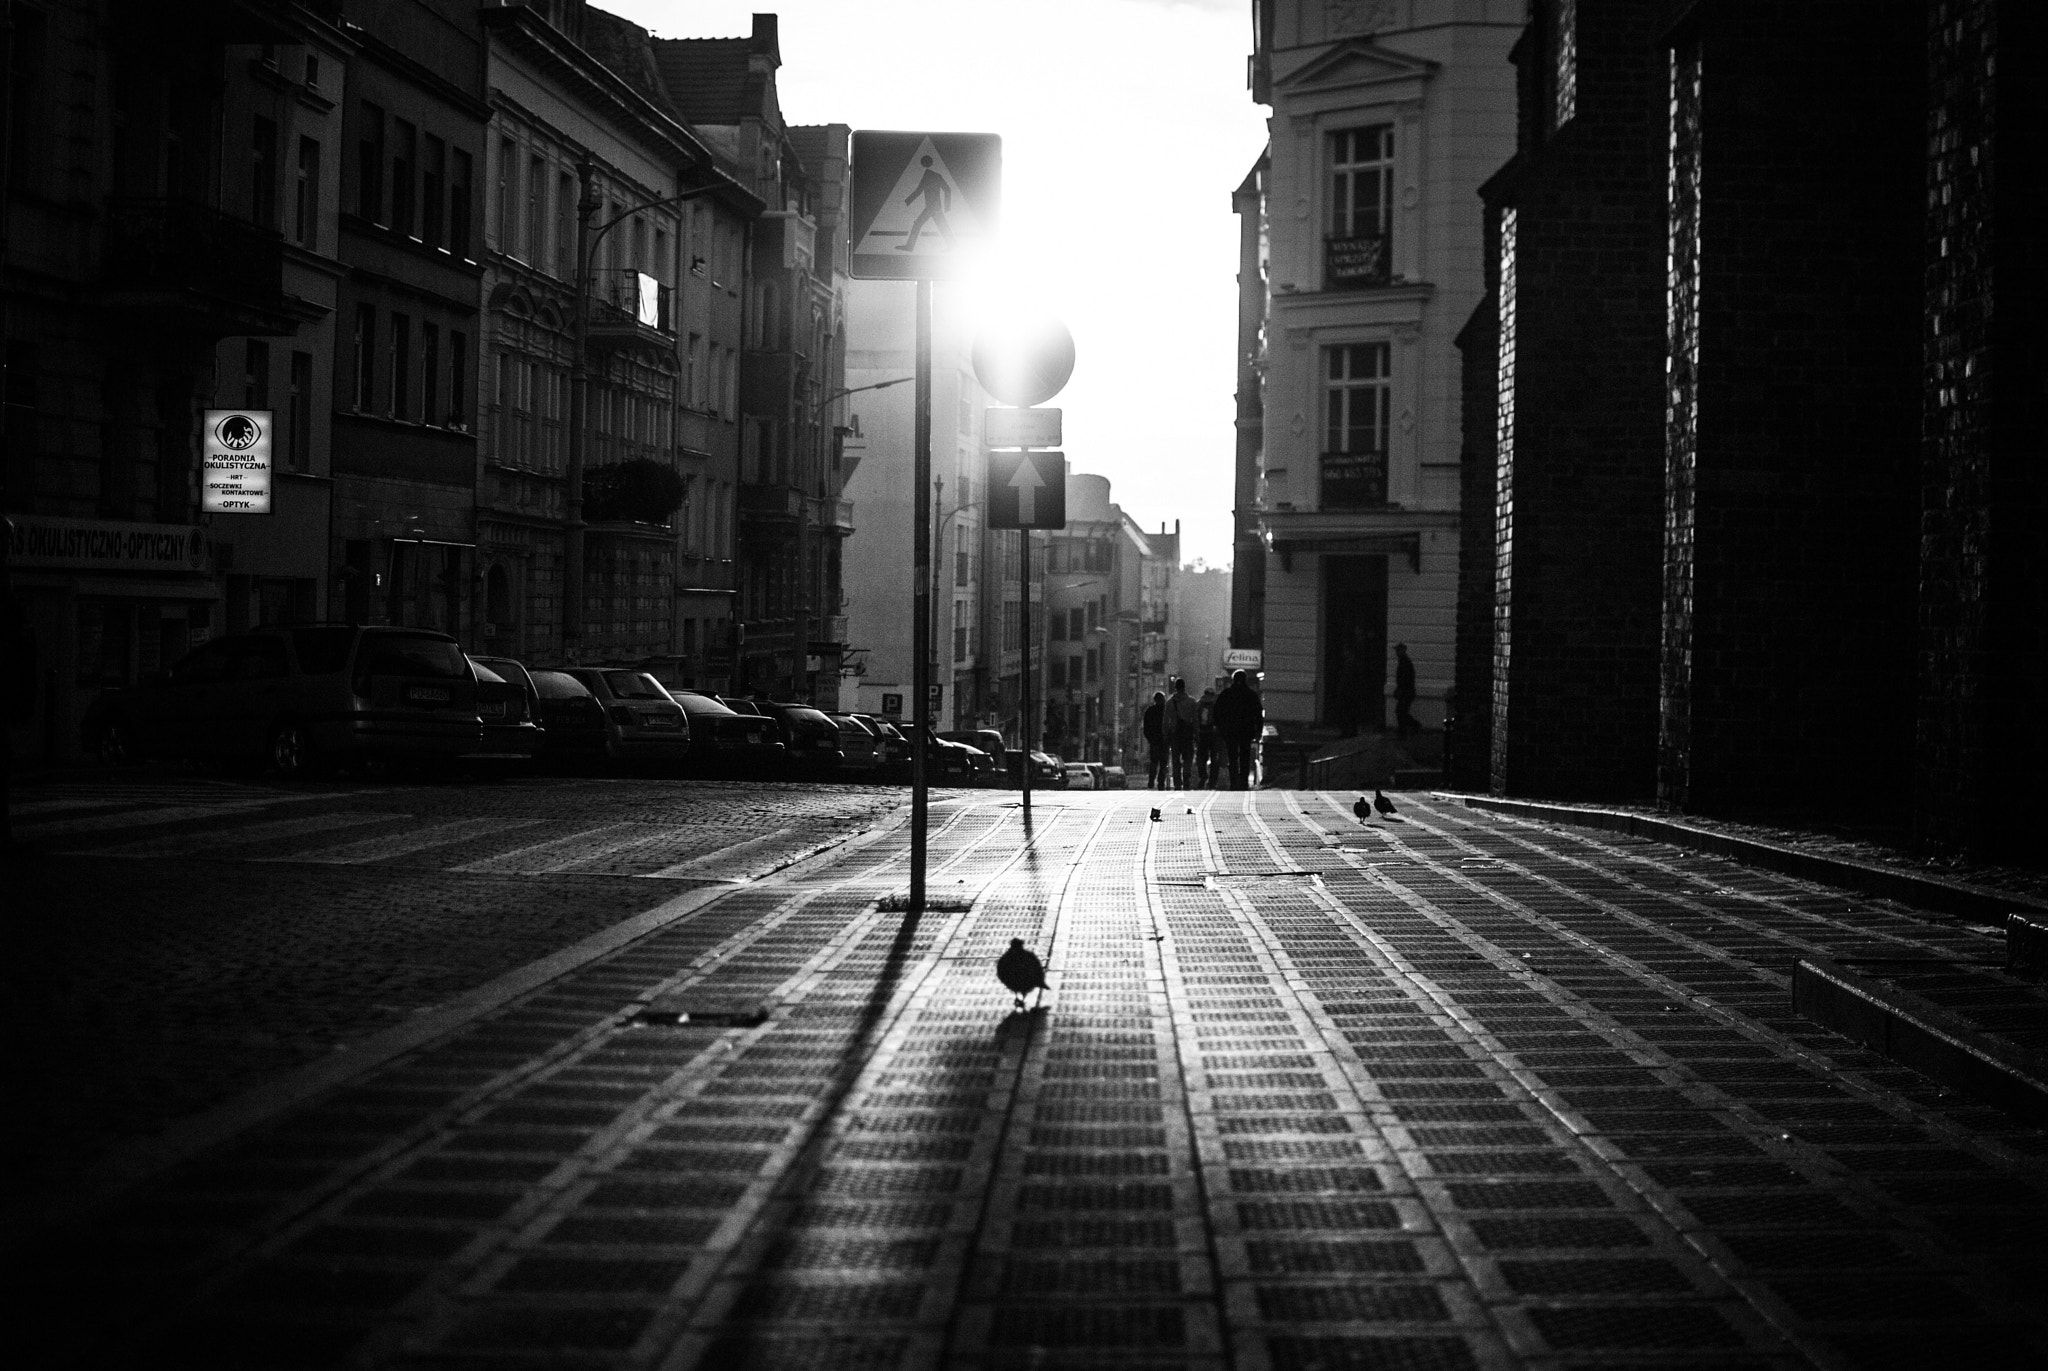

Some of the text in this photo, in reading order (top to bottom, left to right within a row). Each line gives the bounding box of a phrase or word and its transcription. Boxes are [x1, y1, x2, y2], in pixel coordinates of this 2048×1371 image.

[226, 426, 253, 448] VISUS
[29, 527, 185, 561] OKULISTYCZNO-OPTYCZNY
[1227, 651, 1259, 662] felina
